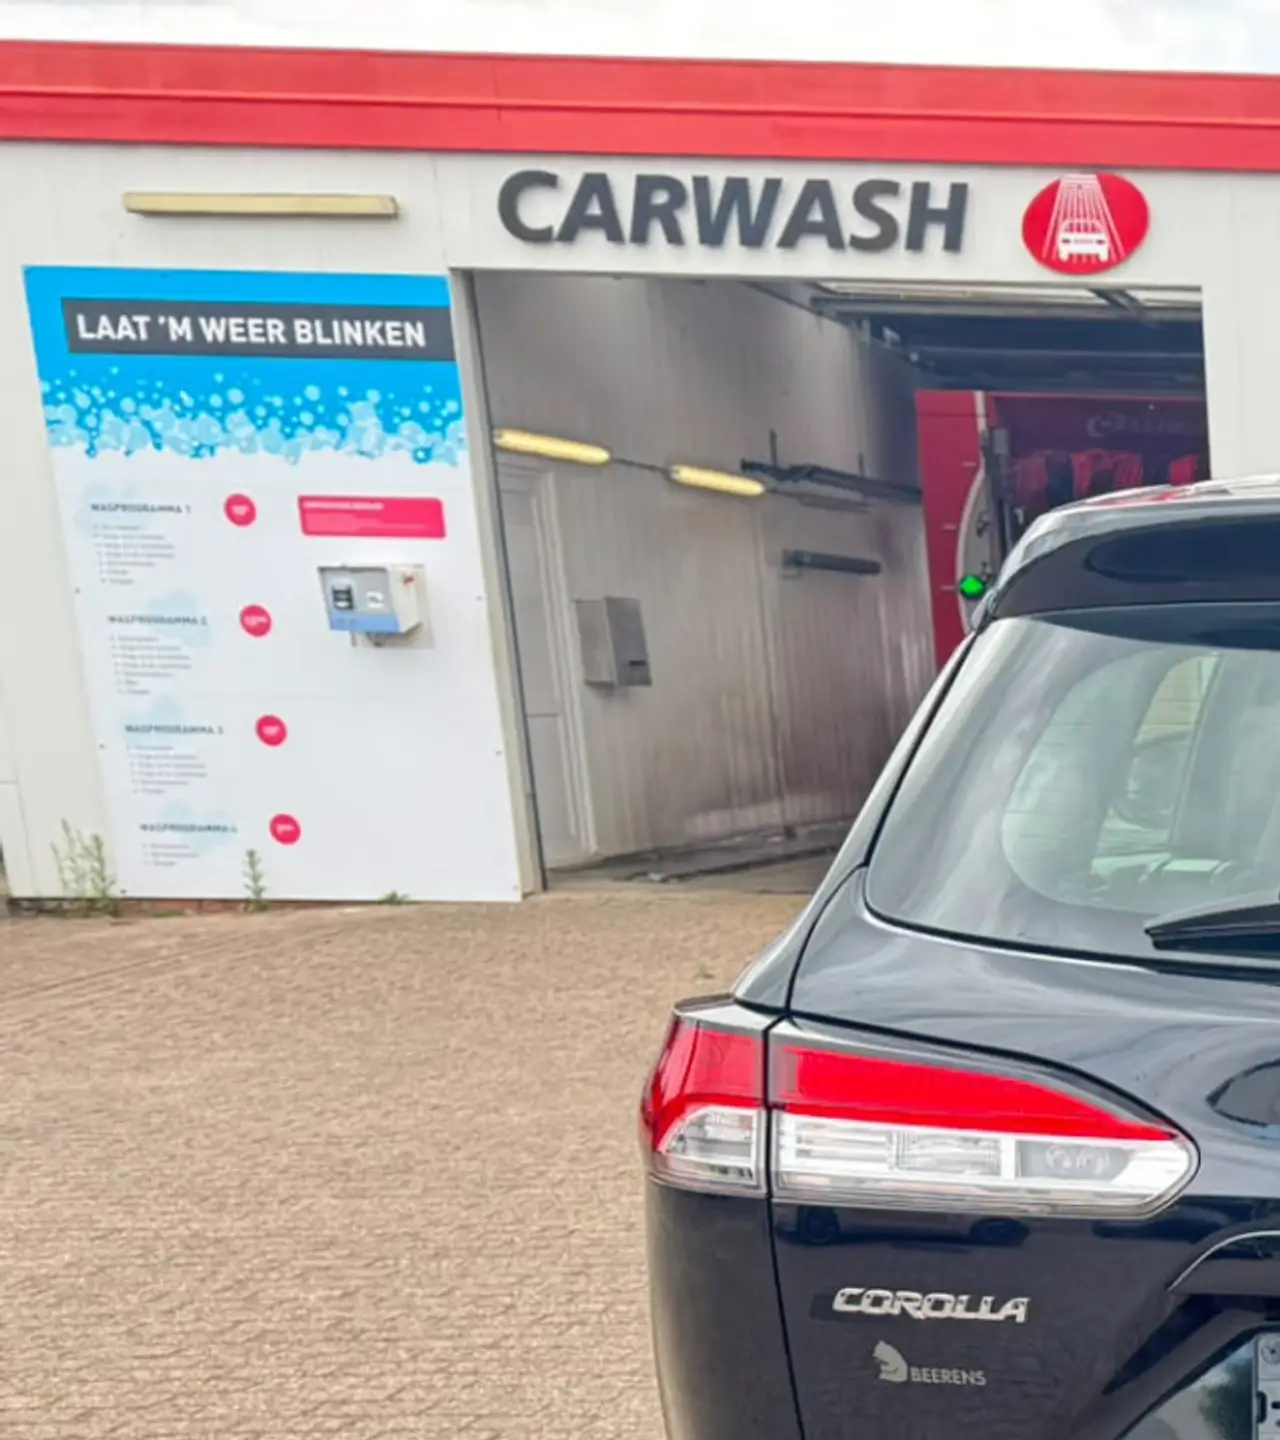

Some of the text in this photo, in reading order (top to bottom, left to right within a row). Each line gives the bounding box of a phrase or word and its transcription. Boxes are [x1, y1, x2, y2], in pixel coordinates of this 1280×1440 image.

[498, 170, 970, 252] CARWASH
[77, 313, 151, 342] LAAT
[199, 317, 286, 345] WEER
[295, 320, 426, 348] BLINKEN
[832, 1286, 1031, 1323] COROLLA
[911, 1367, 987, 1386] BEERENS
